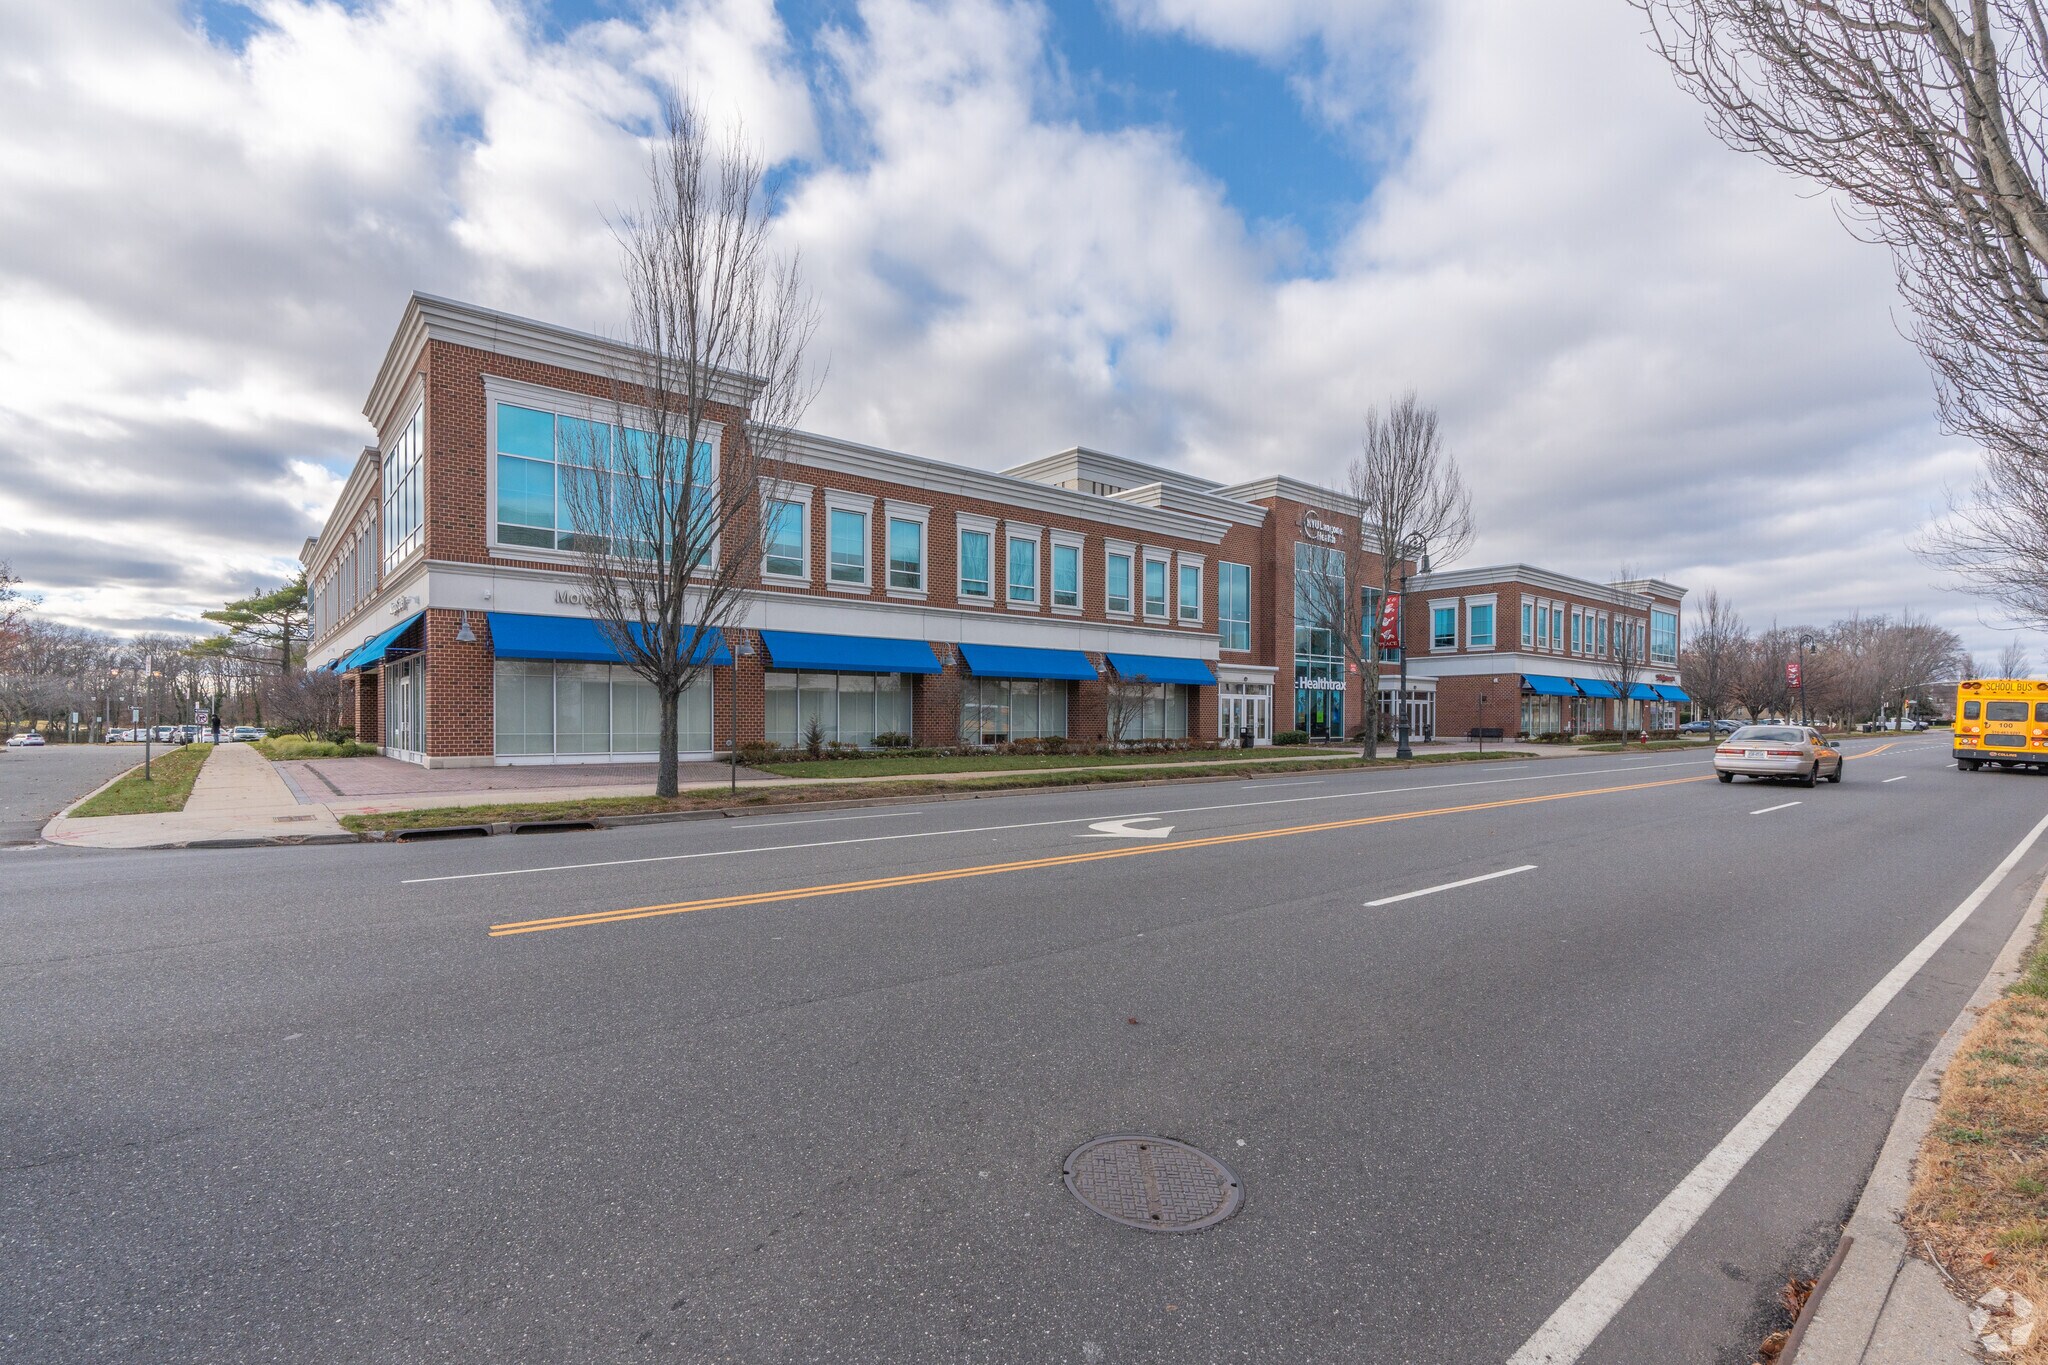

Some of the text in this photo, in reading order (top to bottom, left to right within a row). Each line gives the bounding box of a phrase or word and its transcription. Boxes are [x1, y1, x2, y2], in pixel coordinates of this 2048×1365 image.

[555, 590, 662, 611] Morga Stale
[1299, 676, 1347, 691] Healthtrax
[1986, 683, 2033, 691] SCHOOL BUS
